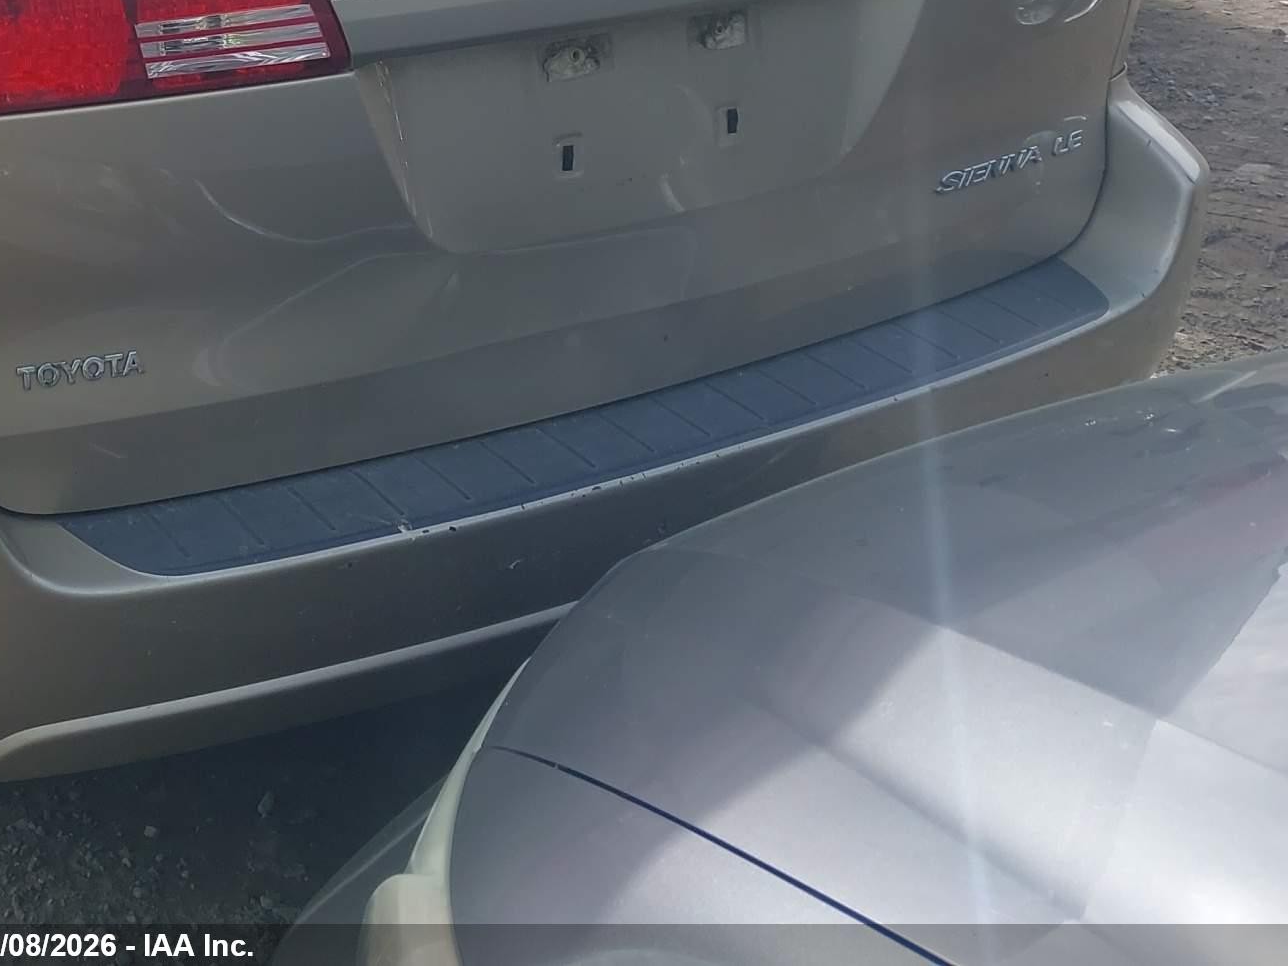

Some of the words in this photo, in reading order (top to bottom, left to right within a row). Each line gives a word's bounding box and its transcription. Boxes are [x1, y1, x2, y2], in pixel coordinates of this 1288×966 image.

[935, 144, 1043, 194] SIENNA
[1052, 129, 1085, 156] LE
[16, 349, 145, 391] TOYOTA
